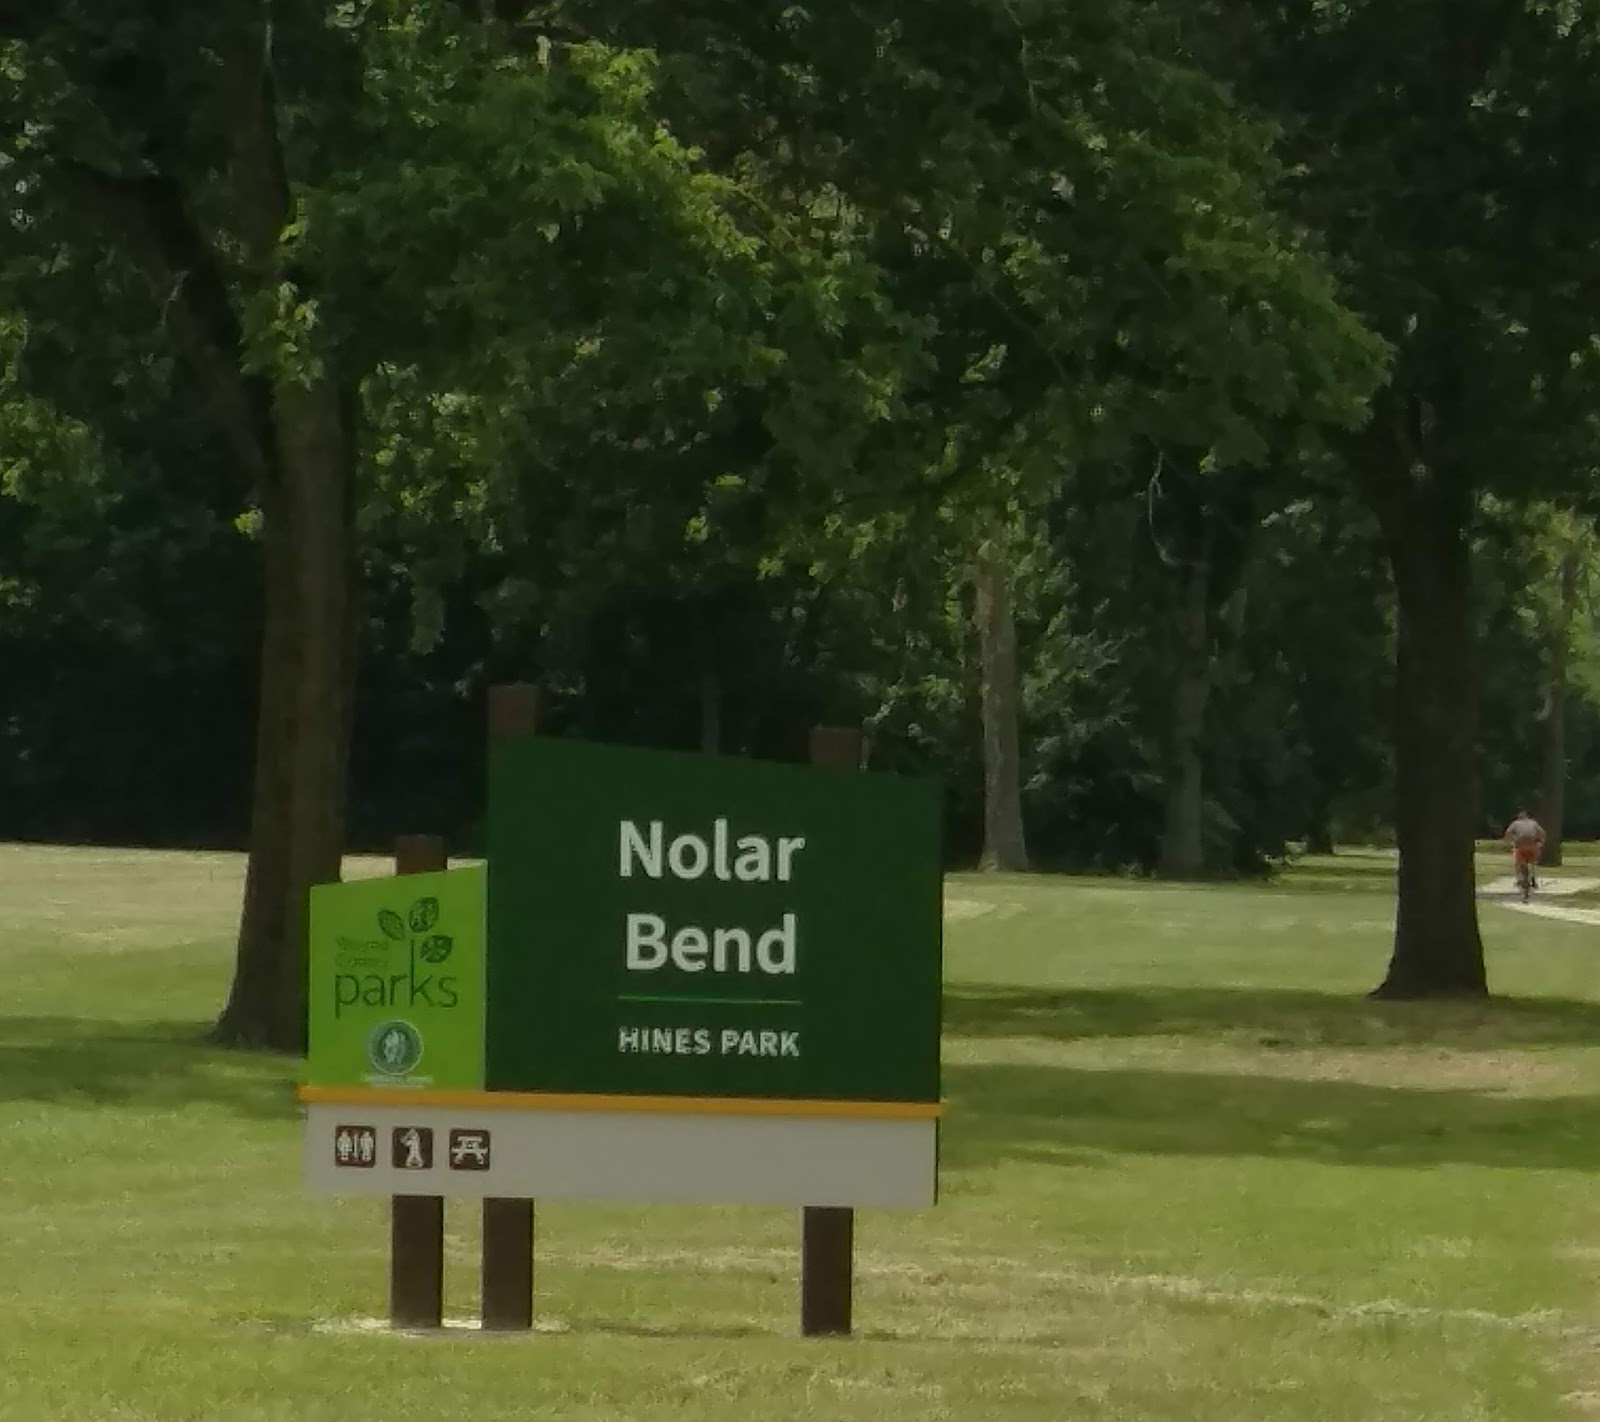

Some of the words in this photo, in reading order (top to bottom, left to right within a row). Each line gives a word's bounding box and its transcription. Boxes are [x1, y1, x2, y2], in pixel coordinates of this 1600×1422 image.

[618, 818, 805, 881] Nolar
[625, 912, 797, 974] Bend
[334, 938, 459, 1020] parks
[618, 1026, 711, 1055] HINES
[721, 1029, 800, 1057] PARK
